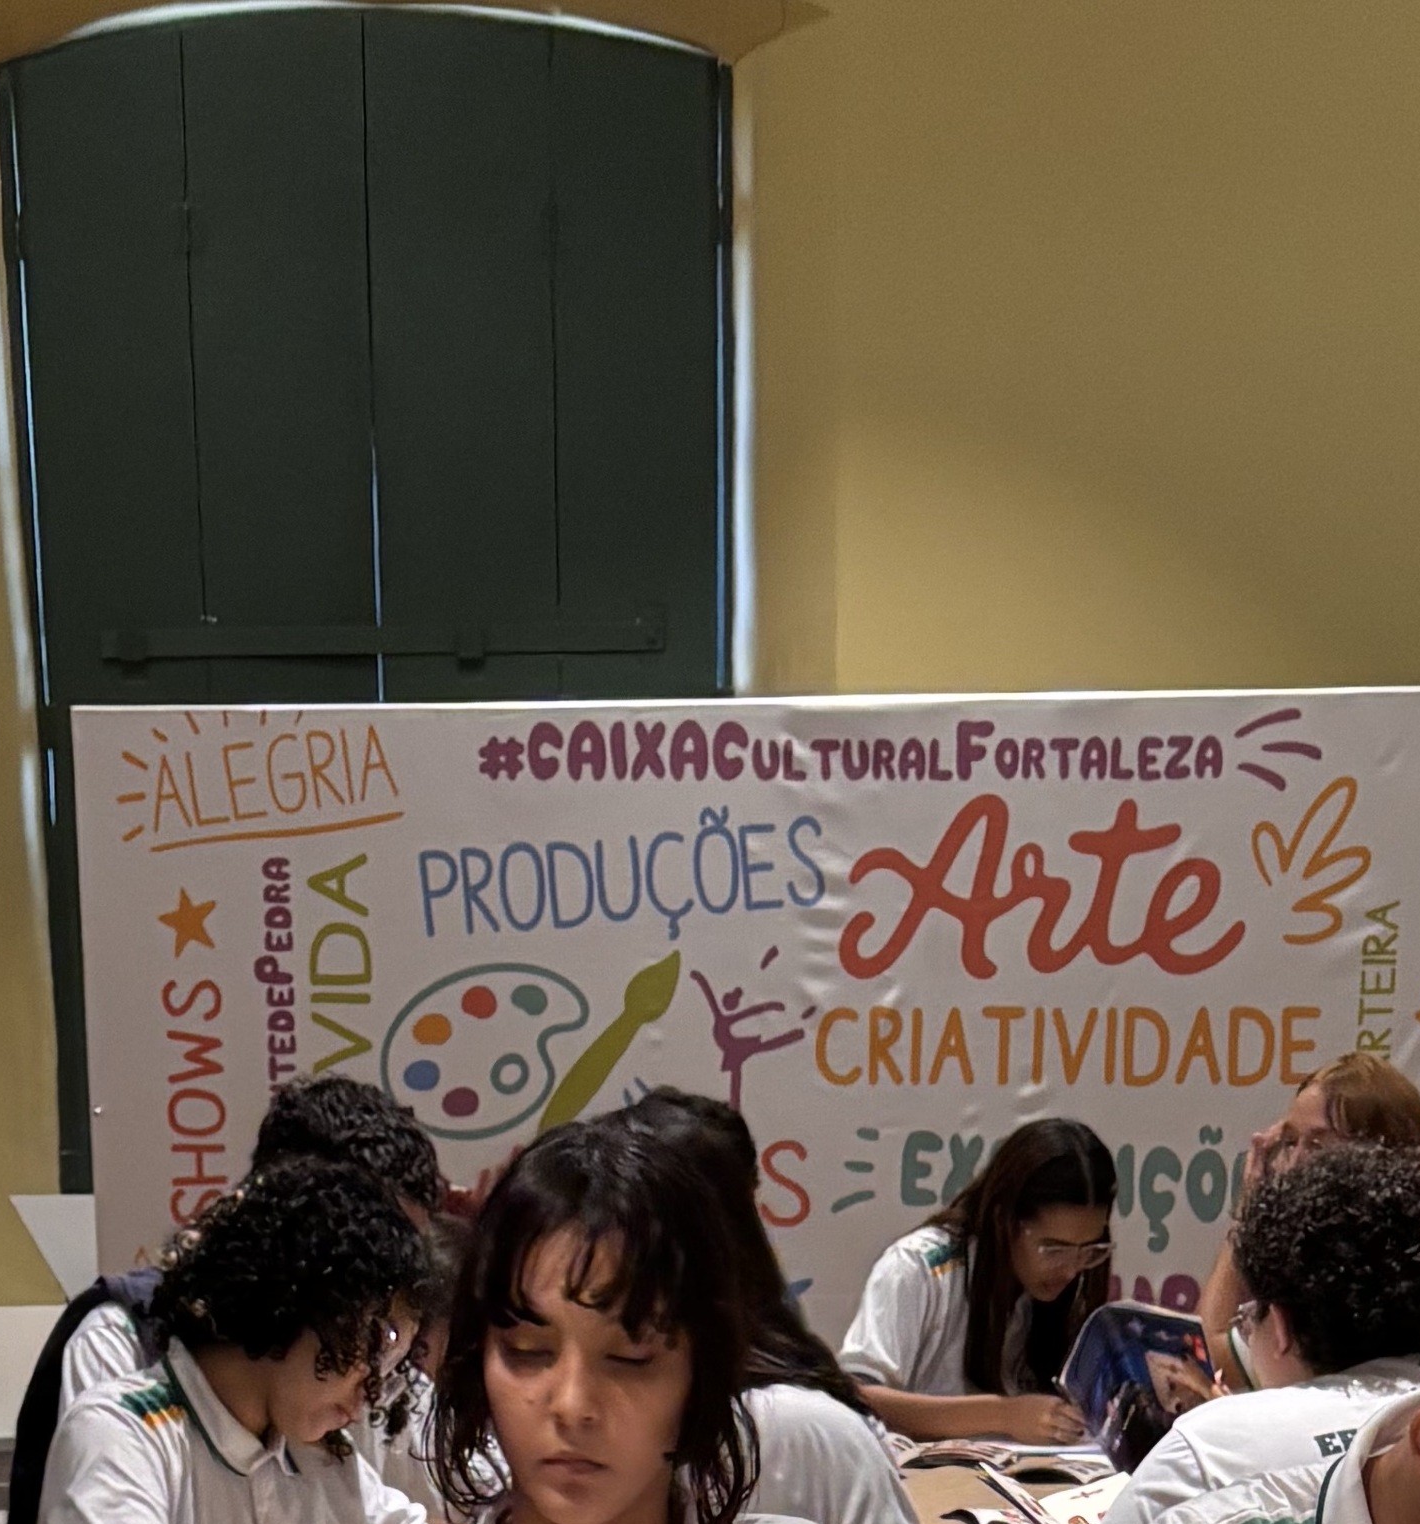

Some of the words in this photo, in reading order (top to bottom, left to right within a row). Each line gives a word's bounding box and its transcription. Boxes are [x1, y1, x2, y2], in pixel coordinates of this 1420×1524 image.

[152, 723, 399, 833] ALEGRIA
[418, 806, 825, 940] PRODUÇÕES
[837, 793, 1246, 981] Arte
[306, 852, 373, 1075] VIDA
[1356, 900, 1401, 1061] RTEIRA
[161, 978, 228, 1228] SHOWS
[814, 1005, 1323, 1088] CRIATIVIDADE
